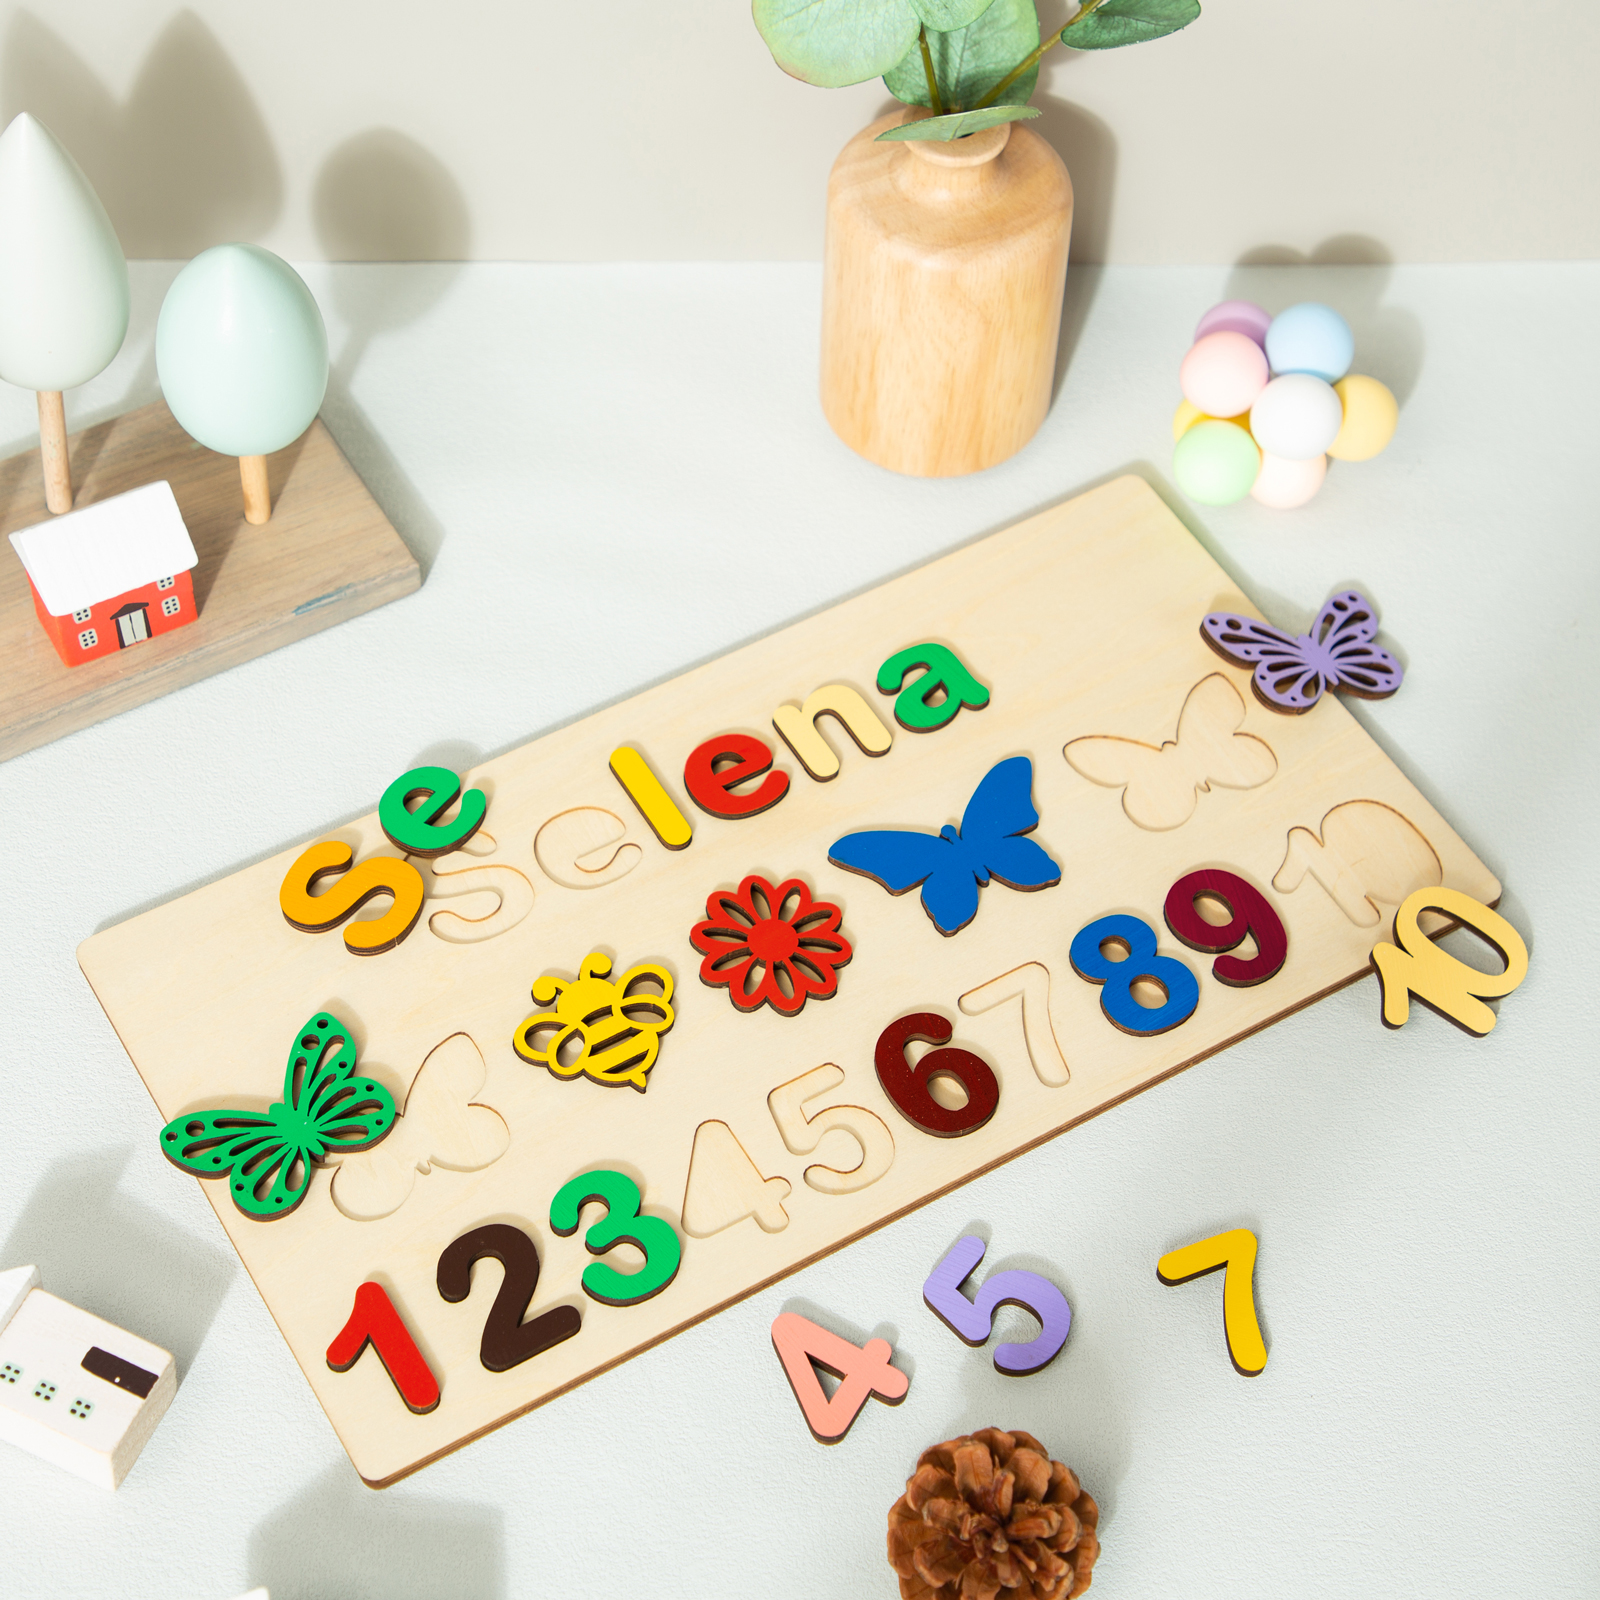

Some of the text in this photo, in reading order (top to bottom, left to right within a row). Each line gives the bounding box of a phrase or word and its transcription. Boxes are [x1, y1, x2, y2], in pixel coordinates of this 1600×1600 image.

[1370, 886, 1528, 1038] 10
[326, 1281, 440, 1414] 1
[437, 1223, 581, 1372] 2
[550, 1170, 681, 1305] 3
[875, 1012, 998, 1138] 6
[1070, 914, 1199, 1036] 8
[1165, 869, 1287, 987] 9
[923, 1236, 1070, 1377] 5
[1156, 1228, 1267, 1377] 7
[771, 1312, 908, 1445] 4
